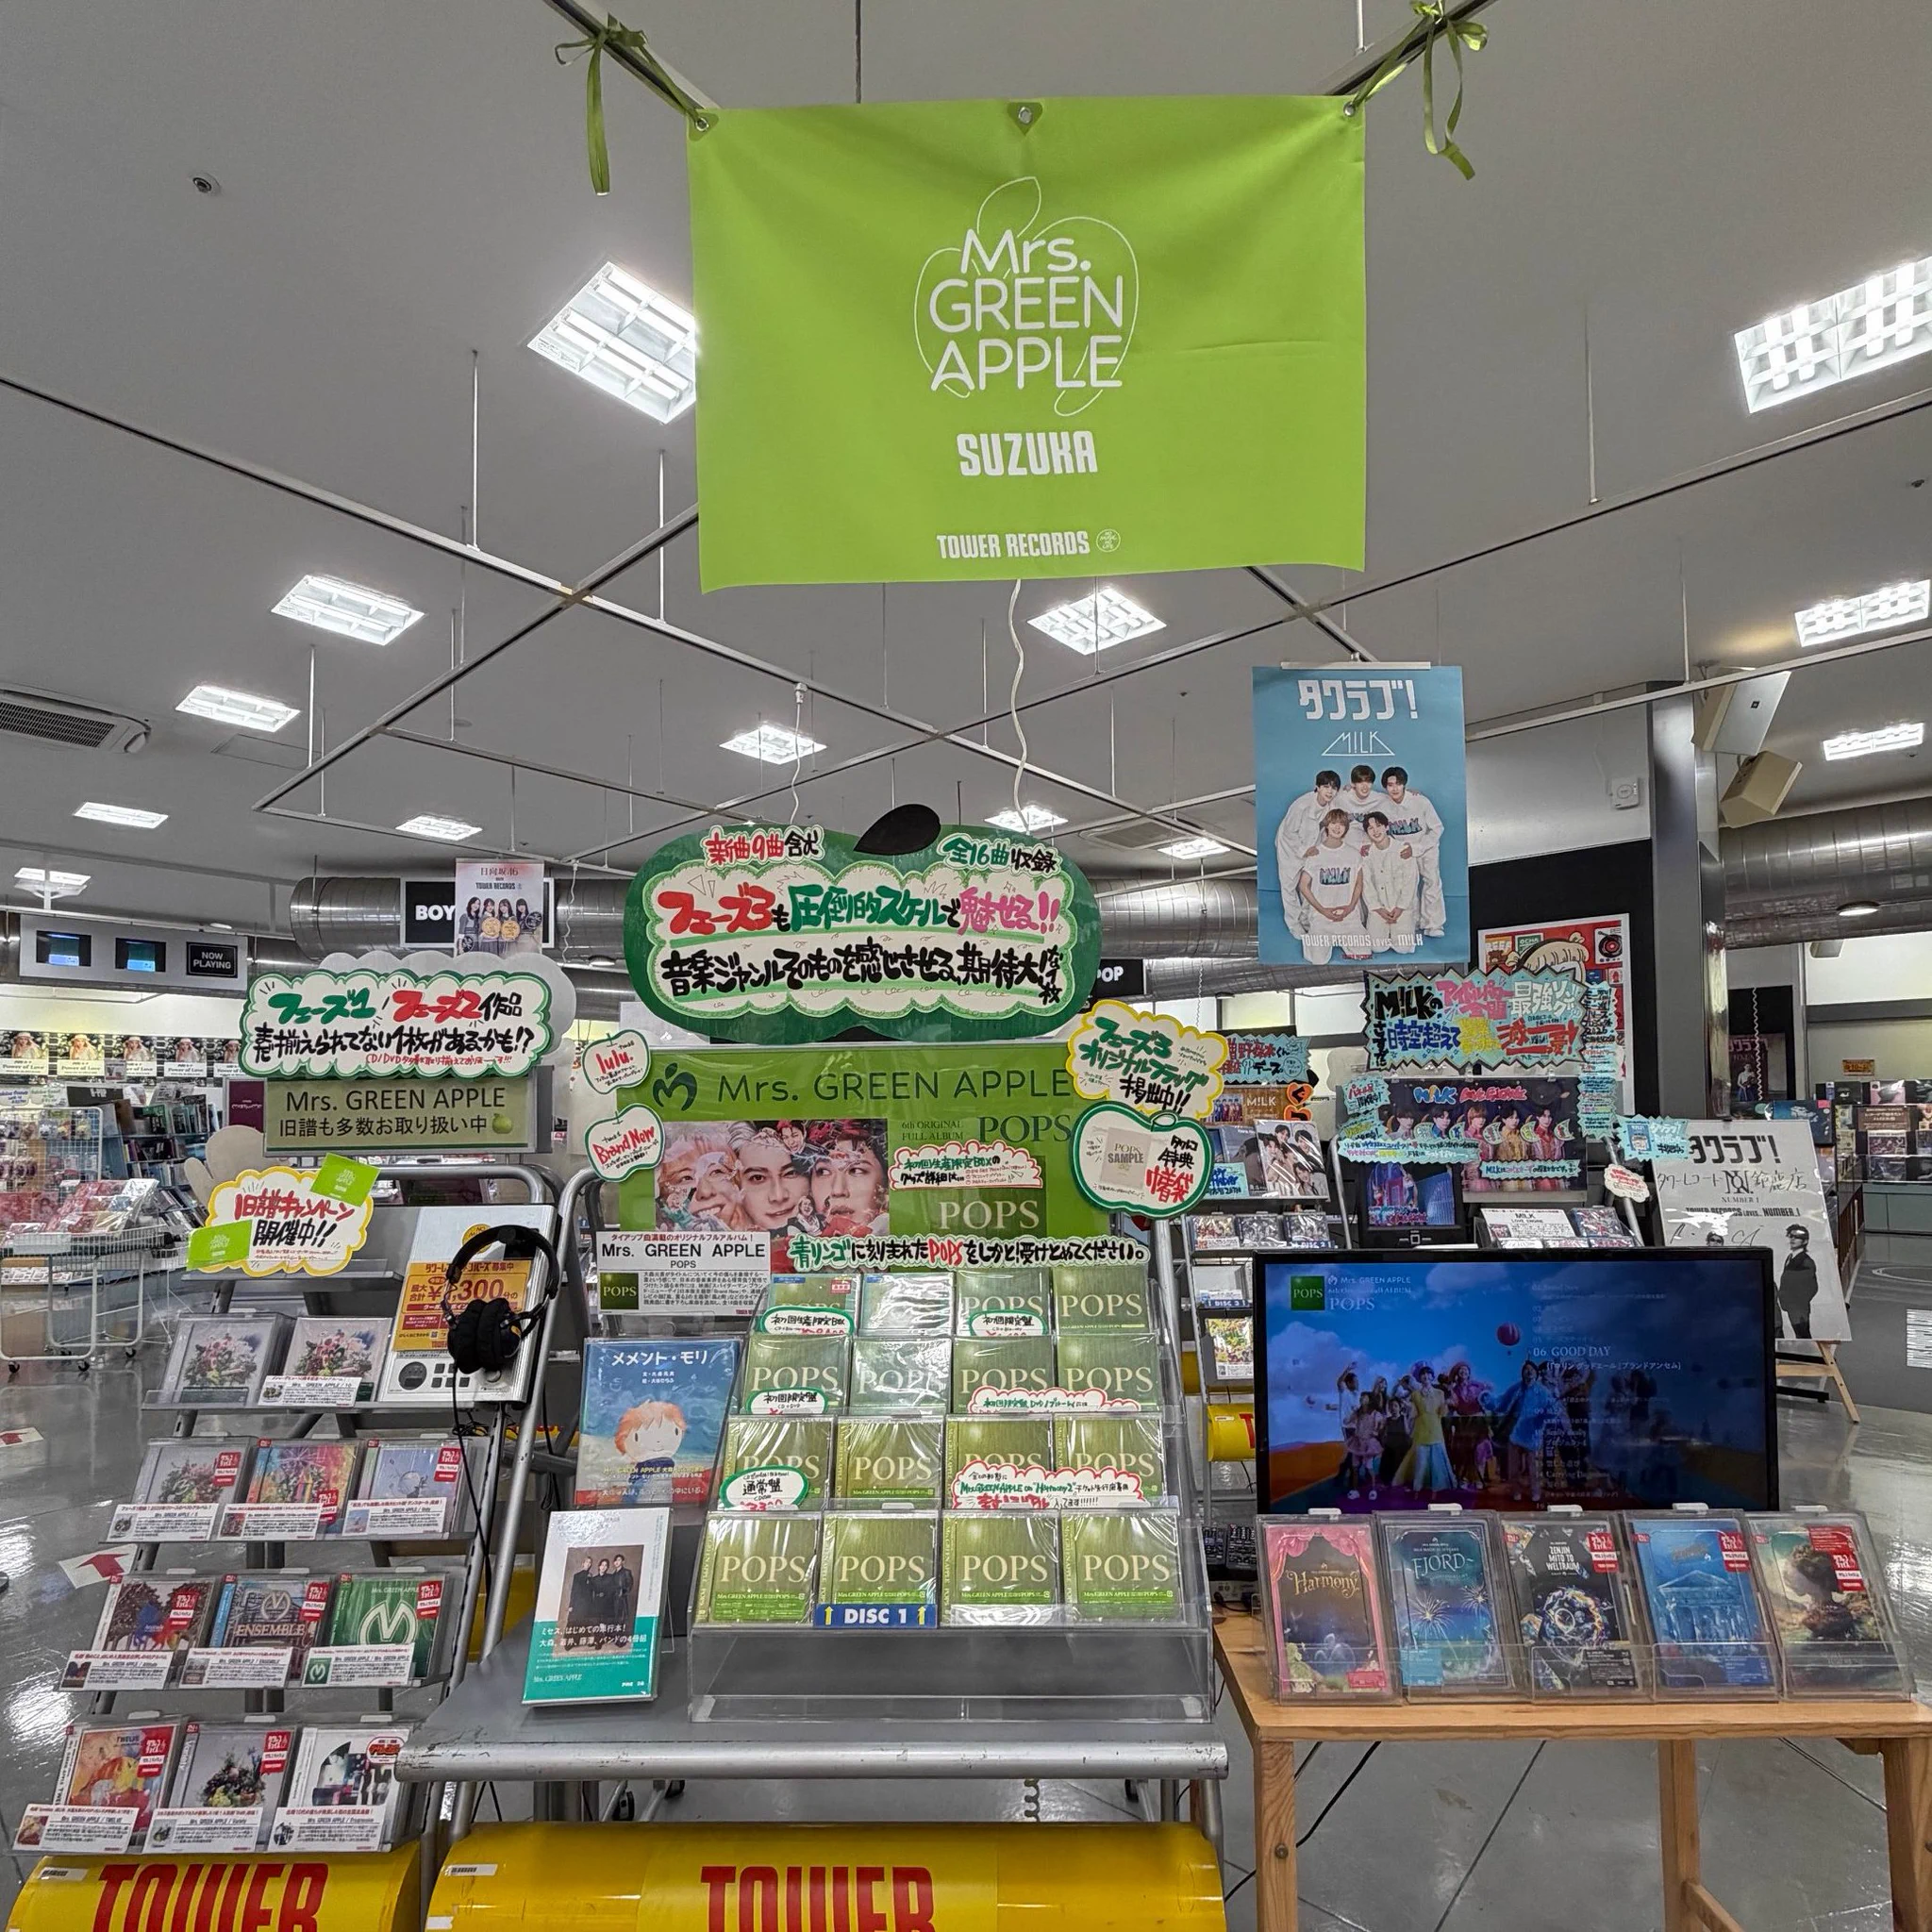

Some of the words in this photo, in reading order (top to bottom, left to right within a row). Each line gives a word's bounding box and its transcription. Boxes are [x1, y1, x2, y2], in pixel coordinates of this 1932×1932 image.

[960, 229, 1091, 275] Mrs.
[929, 275, 1123, 333] GREEN
[931, 335, 1123, 391] APPLE
[957, 431, 1098, 476] SUZUKA
[937, 534, 1001, 558] TOWER
[1005, 531, 1091, 557] RECORDS
[942, 836, 1058, 873] 全16曲収録
[192, 959, 231, 970] PLAYING
[201, 951, 224, 960] NOW
[1095, 1017, 1173, 1058] フェーズ3
[718, 1075, 798, 1103] Mrs.
[814, 1072, 939, 1101] GREEN
[954, 1069, 1071, 1098] APPLE
[287, 1091, 338, 1111] Mrs.
[346, 1089, 425, 1110] GREEN
[434, 1087, 505, 1108] APPLE
[279, 1114, 487, 1138] 旧譜も多数お取り扱い中
[902, 1121, 915, 1129] 6th
[917, 1121, 961, 1129] ORIGINAL
[927, 1132, 964, 1141] ALBUM
[977, 1115, 1072, 1143] POPS
[1108, 1152, 1143, 1164] SAMPLE
[938, 1200, 1040, 1230] POPS
[253, 1218, 337, 1247] 開催中!!
[601, 1243, 635, 1257] Mrs.
[645, 1243, 702, 1257] GREEN
[711, 1243, 766, 1257] APPLE
[670, 1260, 697, 1269] POPS
[603, 1286, 637, 1297] POPS
[1293, 1289, 1323, 1298] POPS
[1329, 1297, 1375, 1310] POPS
[1060, 1293, 1142, 1318] POPS
[611, 1350, 708, 1367] メメント・モリ
[1533, 1347, 1547, 1357] 06
[1551, 1346, 1587, 1357] GOOD
[1589, 1346, 1612, 1357] DAY
[752, 1366, 840, 1392] POPS
[961, 1368, 1048, 1394] POPS
[1065, 1366, 1154, 1393] POPS
[853, 1456, 932, 1481] POPS
[742, 1478, 783, 1496] 通常盤
[1550, 1546, 1571, 1555] ZENJIN
[719, 1556, 806, 1583] POPS
[839, 1556, 926, 1583] POPS
[961, 1555, 1048, 1583] POPS
[1084, 1554, 1171, 1582] POPS
[1546, 1562, 1580, 1572] WELTRAUM
[1287, 1570, 1361, 1598] Harmony
[844, 1608, 890, 1624] DISC
[898, 1608, 908, 1624] 1
[236, 1623, 306, 1638] ENSEMBLE
[700, 1866, 935, 1932] TOWER
